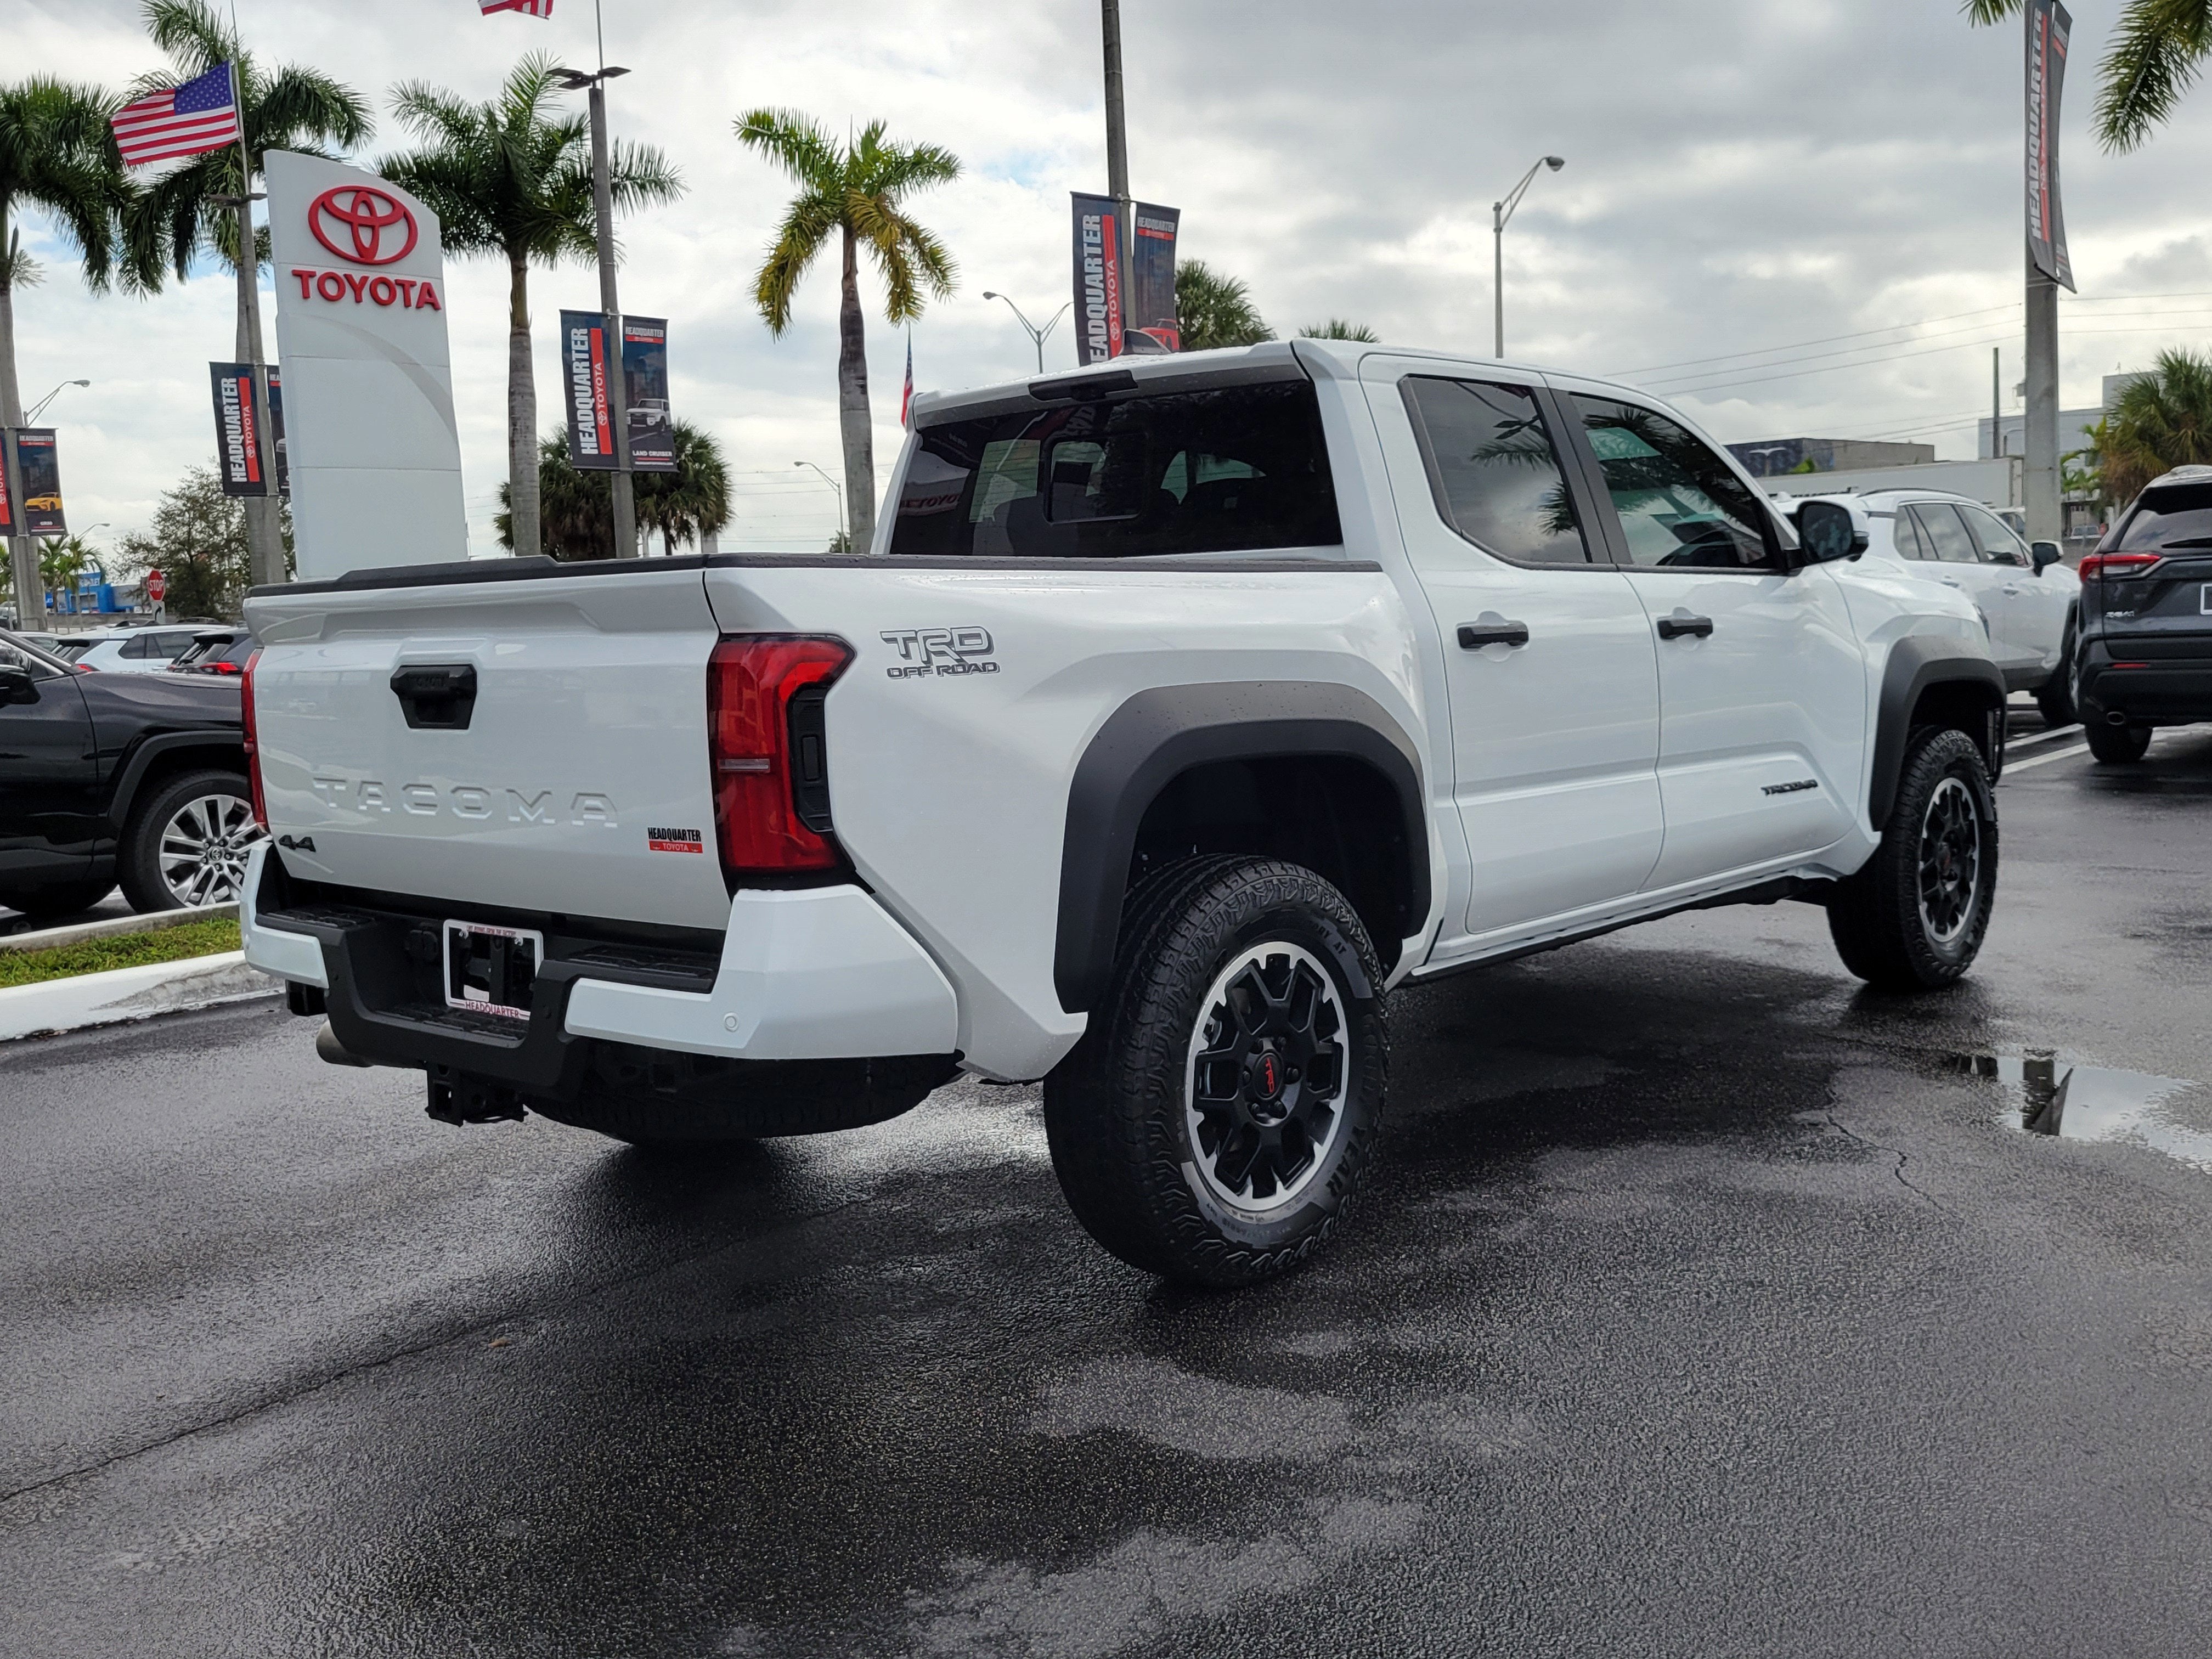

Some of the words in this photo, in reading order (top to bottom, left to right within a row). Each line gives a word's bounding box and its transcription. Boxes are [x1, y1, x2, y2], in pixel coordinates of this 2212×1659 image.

[2029, 7, 2042, 240] HEADQUARTER
[292, 269, 442, 311] TOYOTA
[1082, 215, 1108, 364] EADQUARTER
[1106, 259, 1118, 319] TOYOTA
[571, 328, 599, 454] HEADQUARTER
[594, 363, 605, 409] TOYOTA
[221, 377, 248, 482] HEADQUARTER
[243, 405, 256, 445] TOYOTA
[149, 579, 163, 591] STOP
[879, 626, 995, 666] TRD
[887, 665, 934, 680] OFF
[936, 662, 1001, 677] ROAD
[313, 777, 618, 827] TACOMA
[647, 827, 702, 842] HEADQUARTER
[662, 843, 689, 851] TOYOTA
[466, 1002, 520, 1019] HEADQUARTER
[1265, 1058, 1275, 1093] TRD
